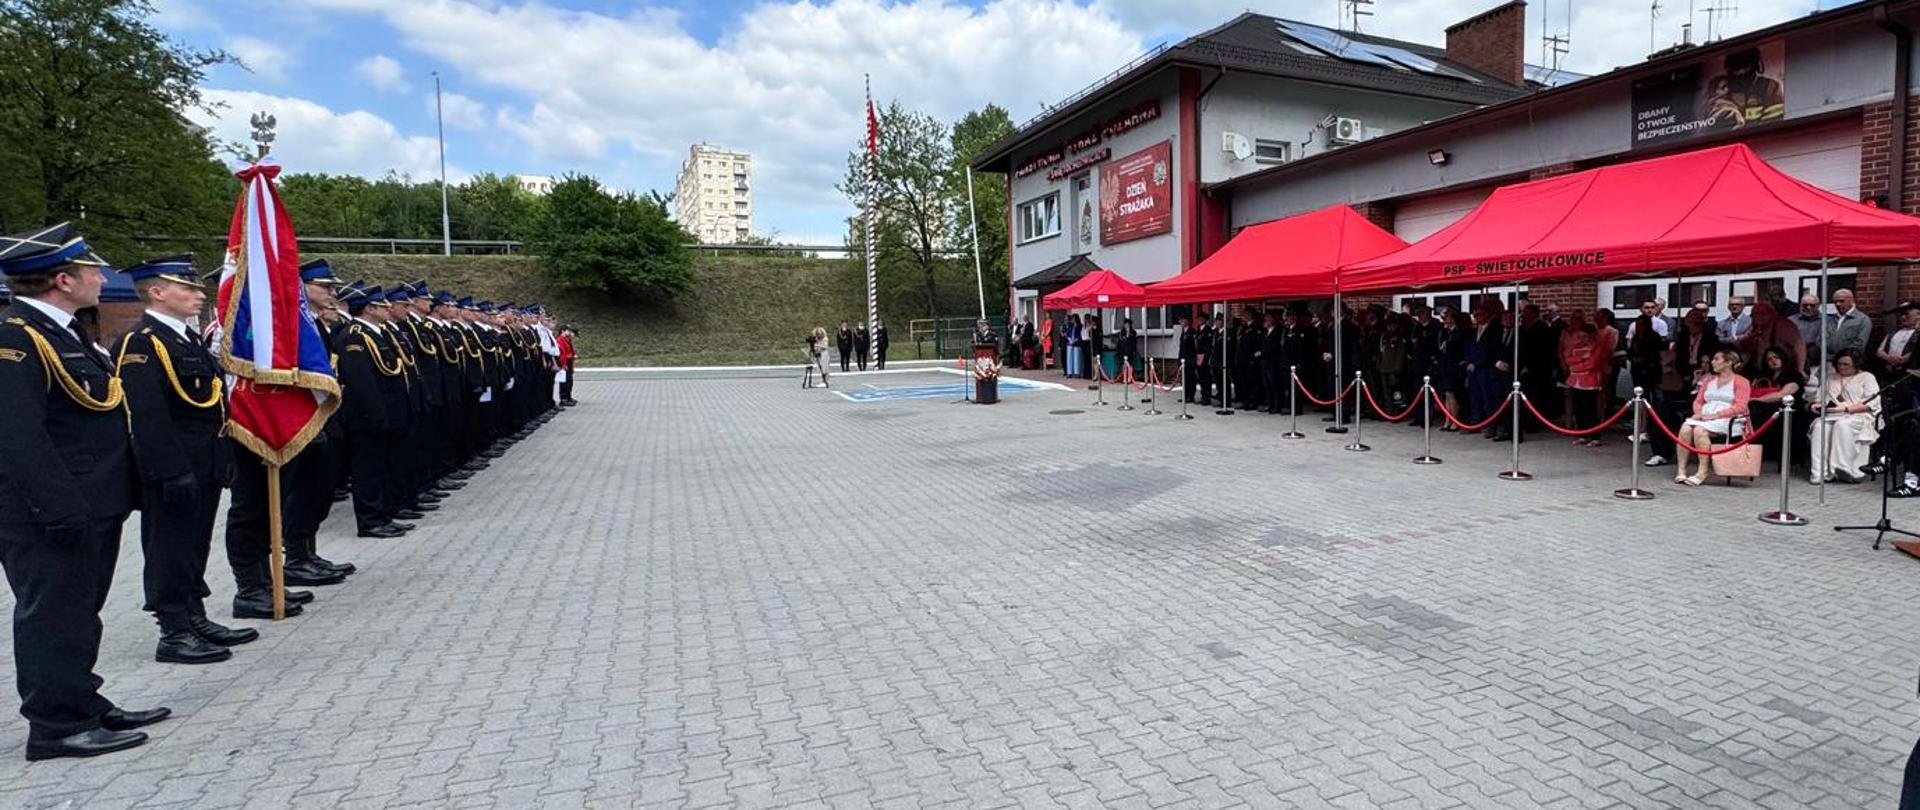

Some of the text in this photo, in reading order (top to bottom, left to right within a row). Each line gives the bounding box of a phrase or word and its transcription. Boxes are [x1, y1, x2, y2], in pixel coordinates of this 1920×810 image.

[1638, 106, 1670, 120] DBAMY
[1638, 115, 1676, 130] O TWOJE
[1444, 264, 1466, 275] PSP
